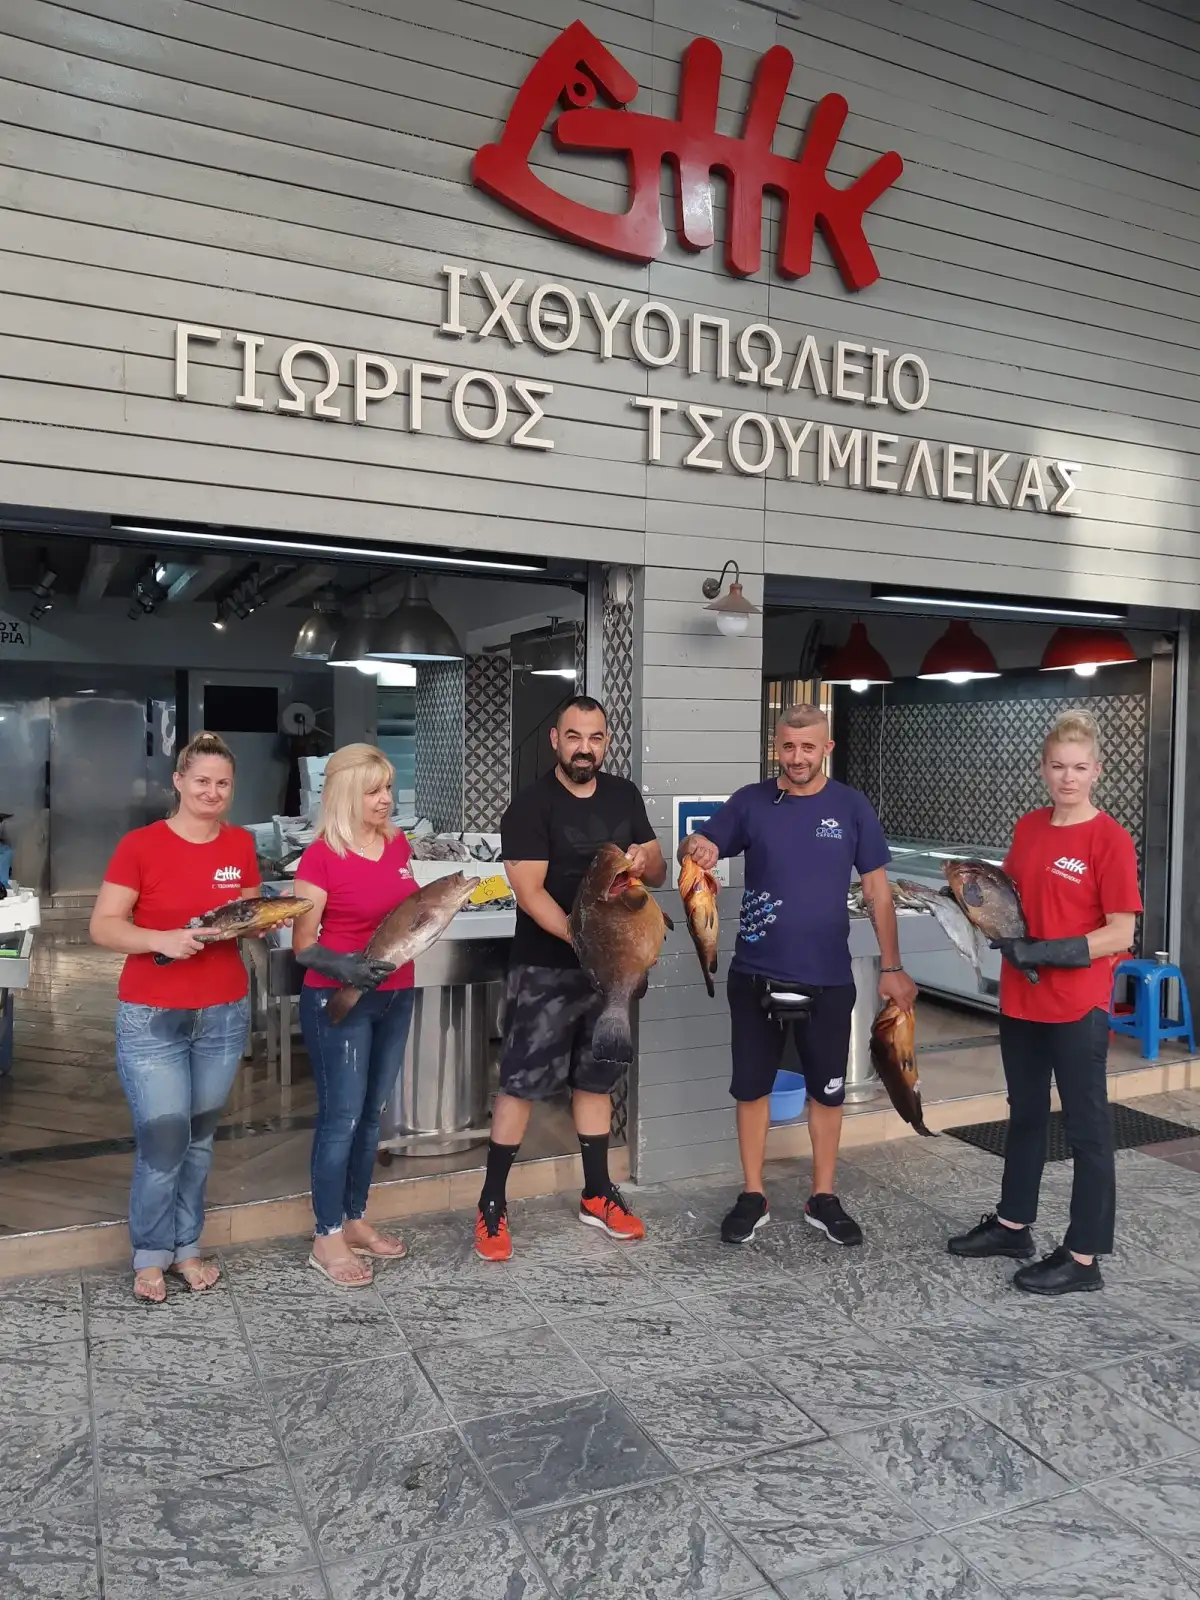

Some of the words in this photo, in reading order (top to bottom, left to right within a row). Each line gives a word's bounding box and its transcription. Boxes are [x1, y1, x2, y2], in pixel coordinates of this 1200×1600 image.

[174, 323, 555, 451] ΓΙΩΡΓΟΣ
[630, 395, 1083, 515] ΤΣΟΥΜΕΛΕΚΑΣ
[440, 265, 930, 412] ΙΧΘΥΟΠΩΛΕΙΟ
